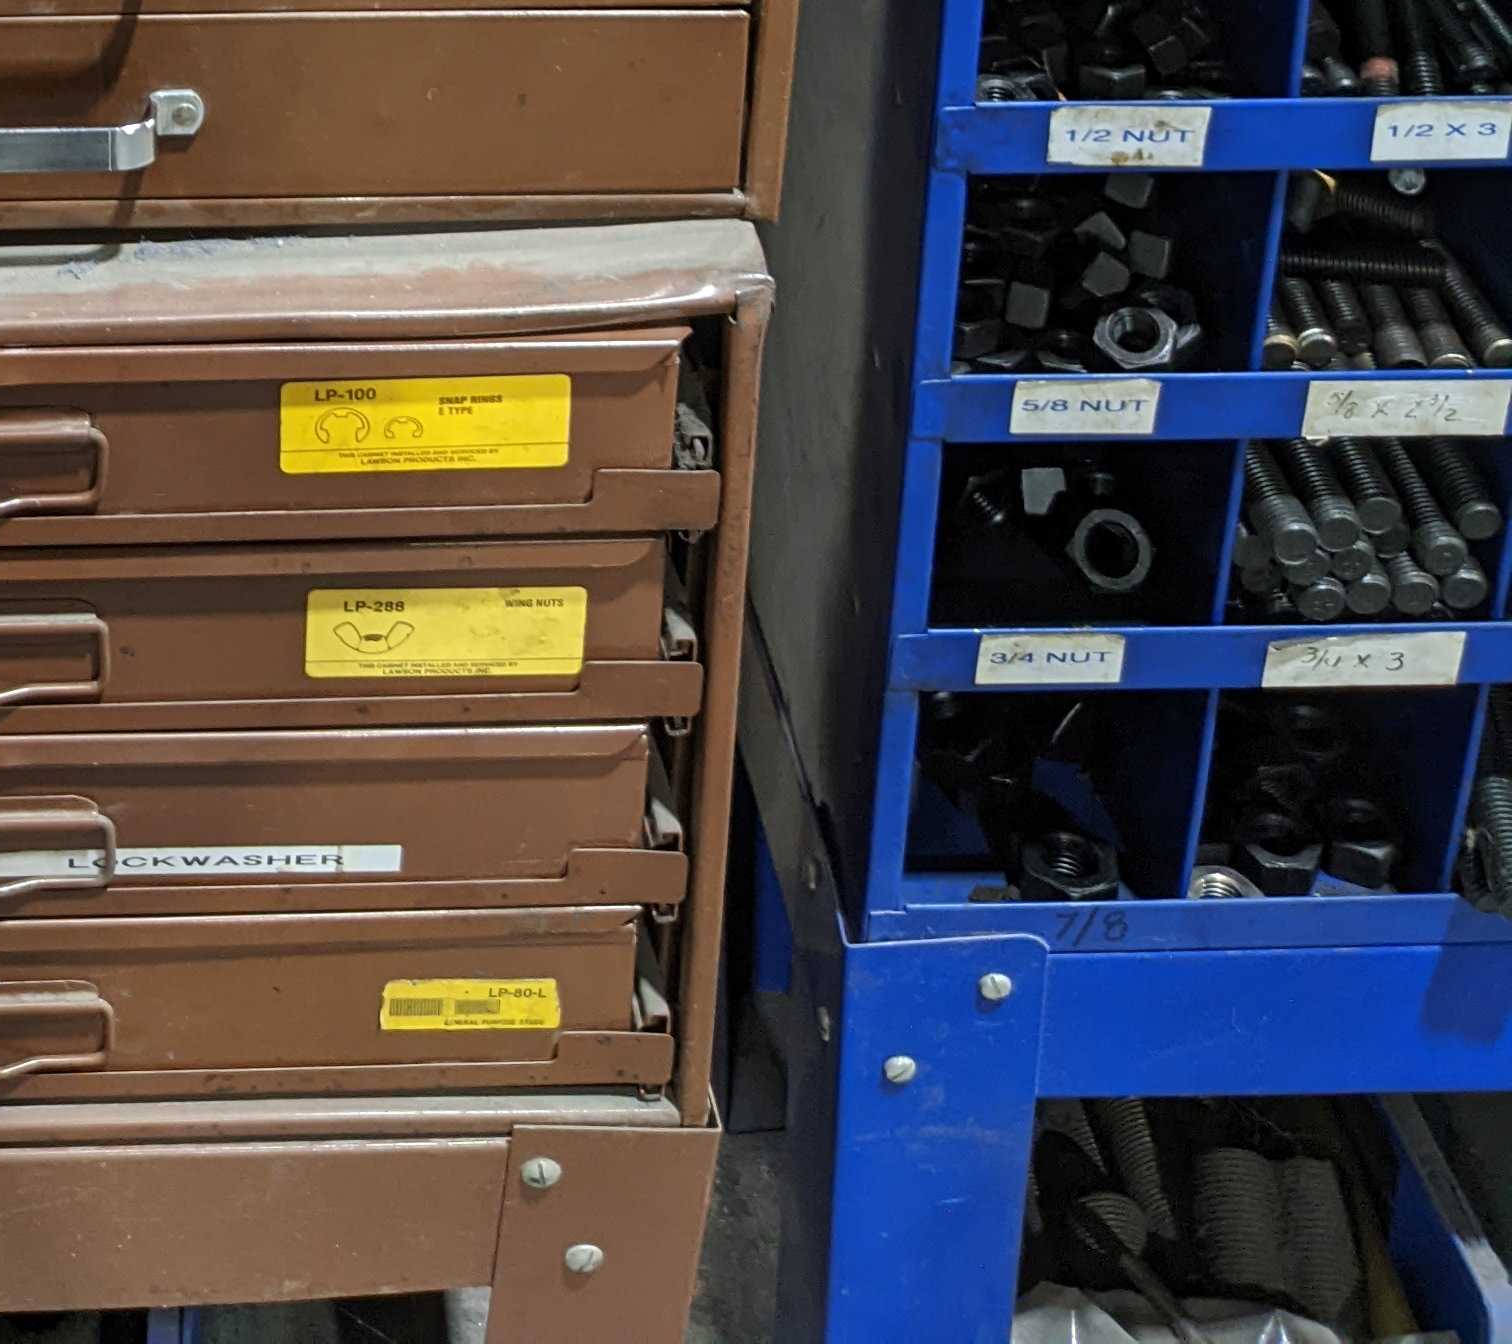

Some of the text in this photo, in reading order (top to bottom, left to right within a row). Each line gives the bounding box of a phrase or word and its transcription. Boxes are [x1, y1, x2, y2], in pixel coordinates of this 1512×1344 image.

[1067, 128, 1195, 144] 1/2 NUT
[1389, 121, 1498, 139] 1/2 X 3
[314, 387, 377, 402] LP-100
[1022, 398, 1148, 413] 5/8 NUT
[343, 600, 405, 613] LP-288
[505, 598, 564, 608] WING NUTS
[990, 650, 1113, 665] 3/4 NUT
[1385, 650, 1405, 671] 3
[1054, 906, 1129, 946] 7/8
[488, 987, 547, 998] LP-80-L
